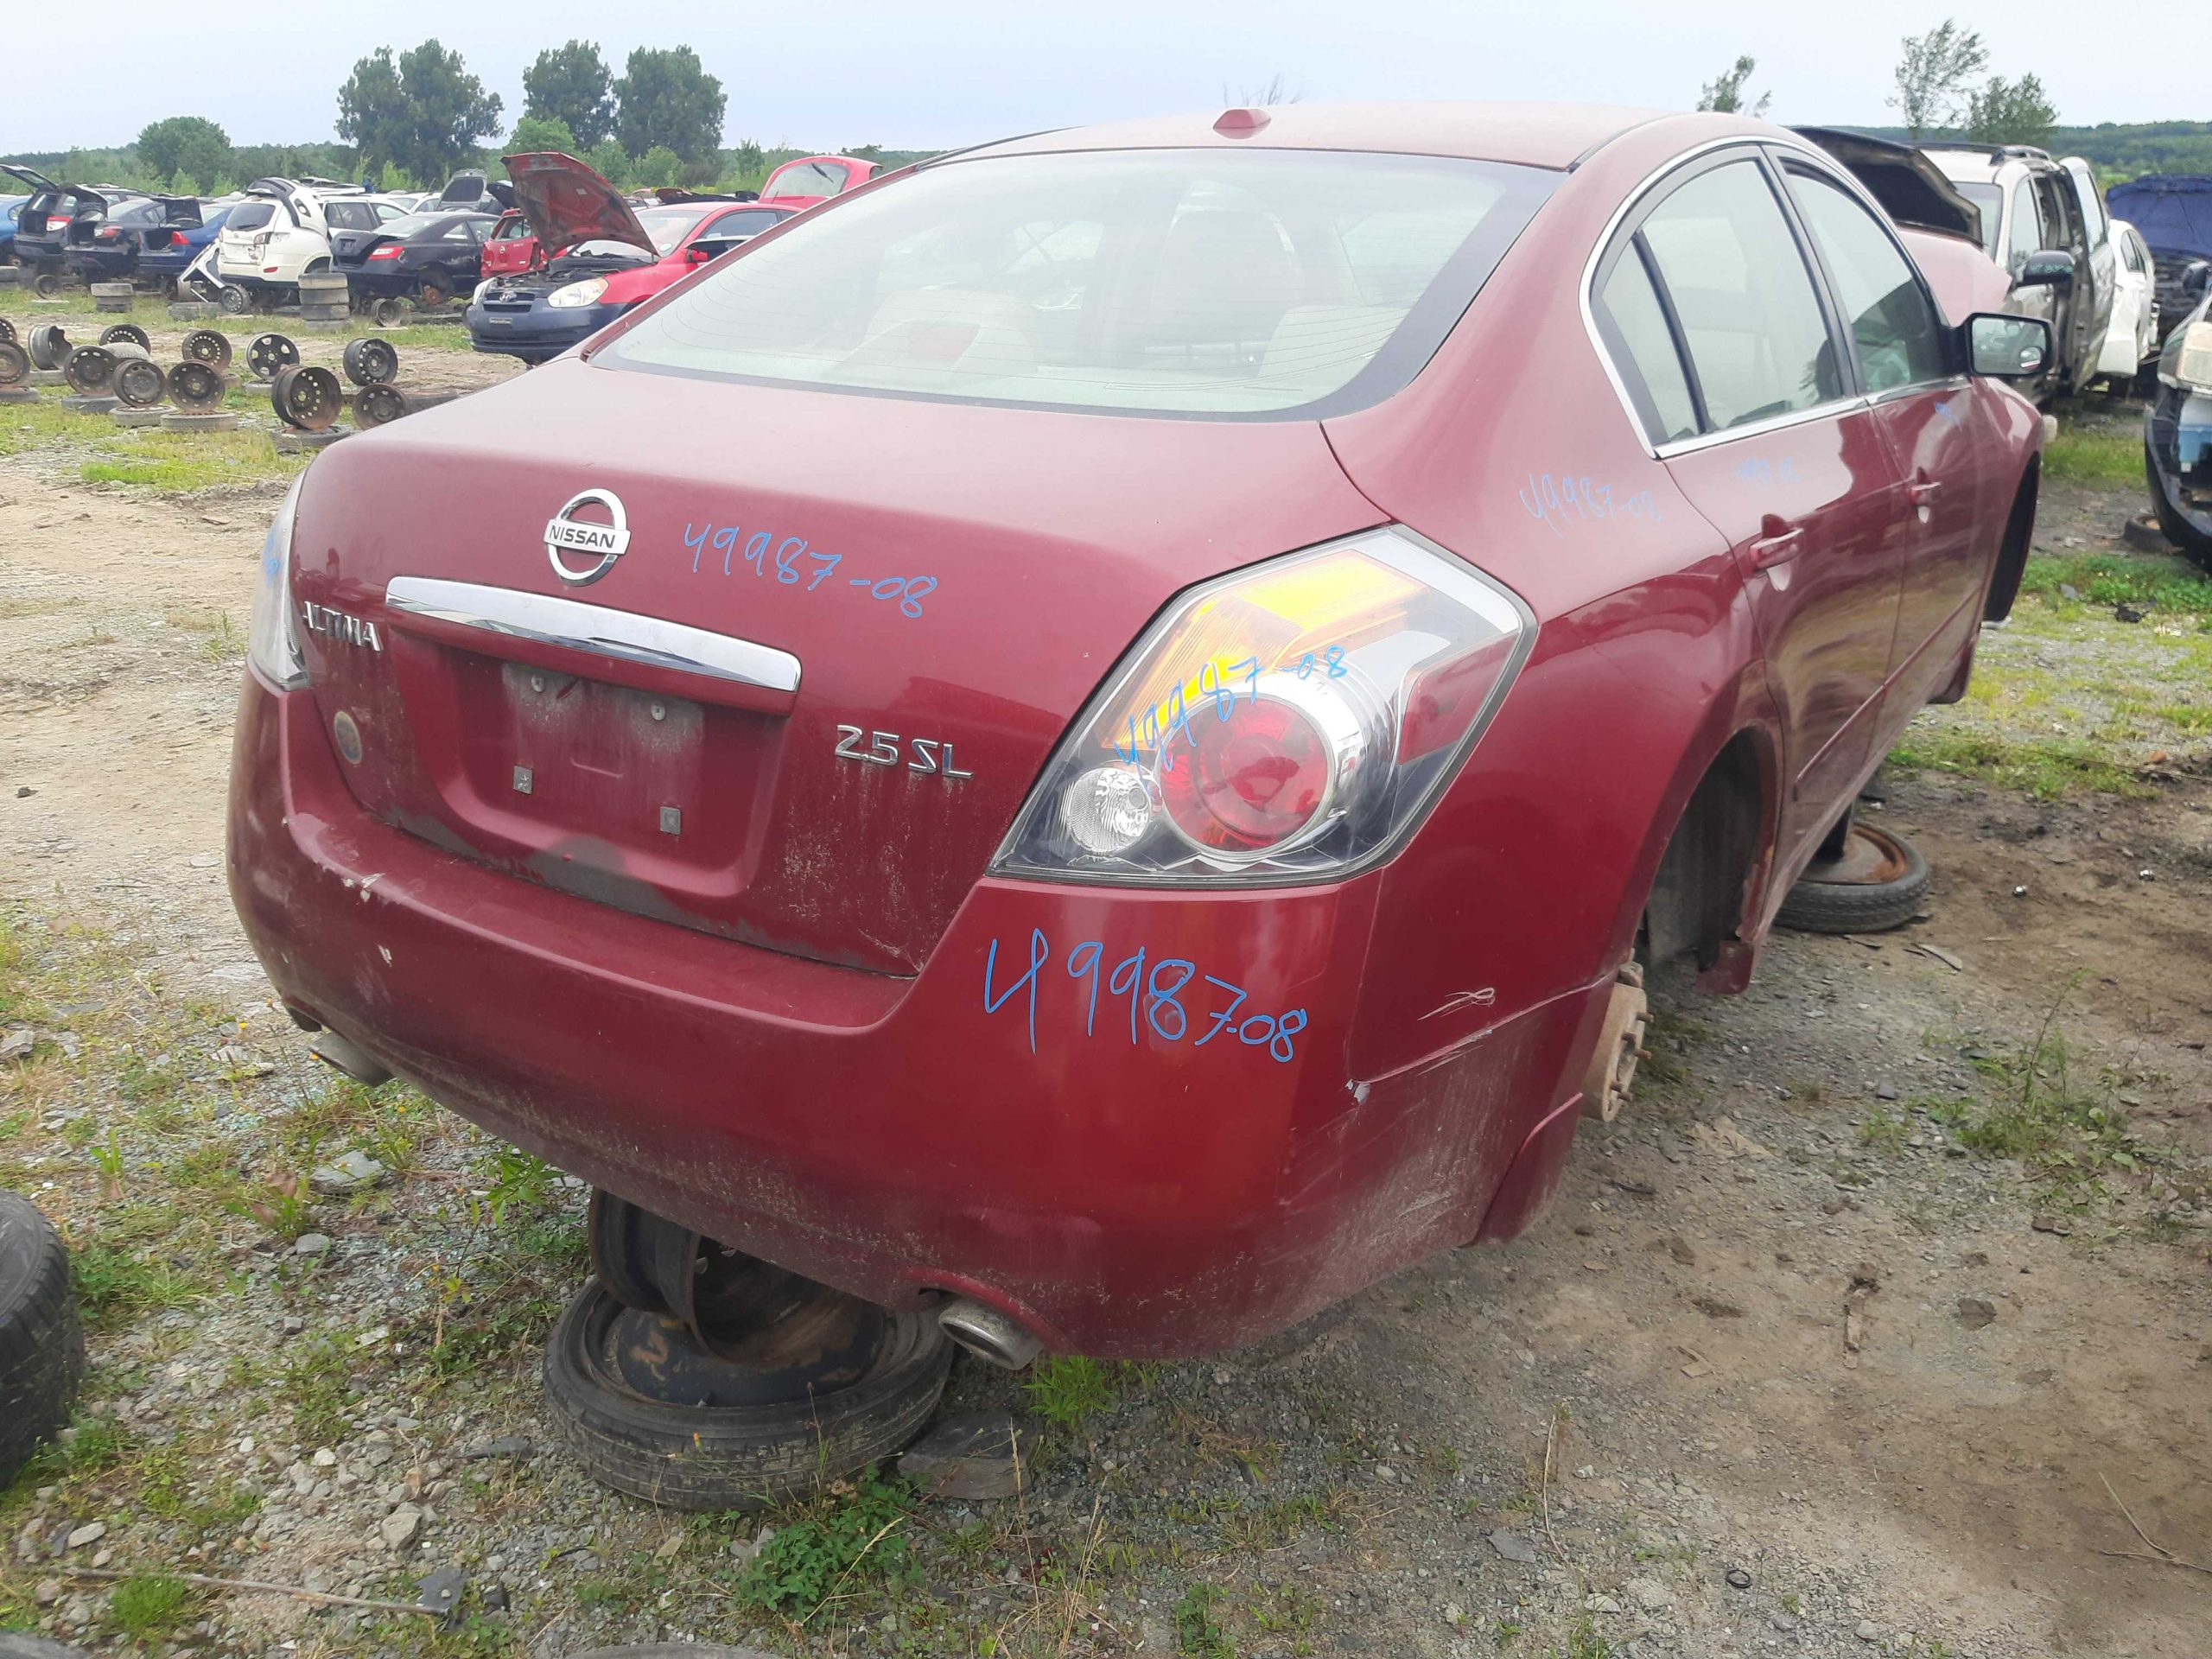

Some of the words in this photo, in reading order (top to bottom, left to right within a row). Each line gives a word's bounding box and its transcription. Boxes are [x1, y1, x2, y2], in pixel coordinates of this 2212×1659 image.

[549, 524, 615, 549] NISSAN
[683, 523, 938, 618] 49987-08
[908, 739, 974, 779] SL
[1113, 645, 1348, 802] 49987-08
[984, 927, 1307, 1063] 49987-08
